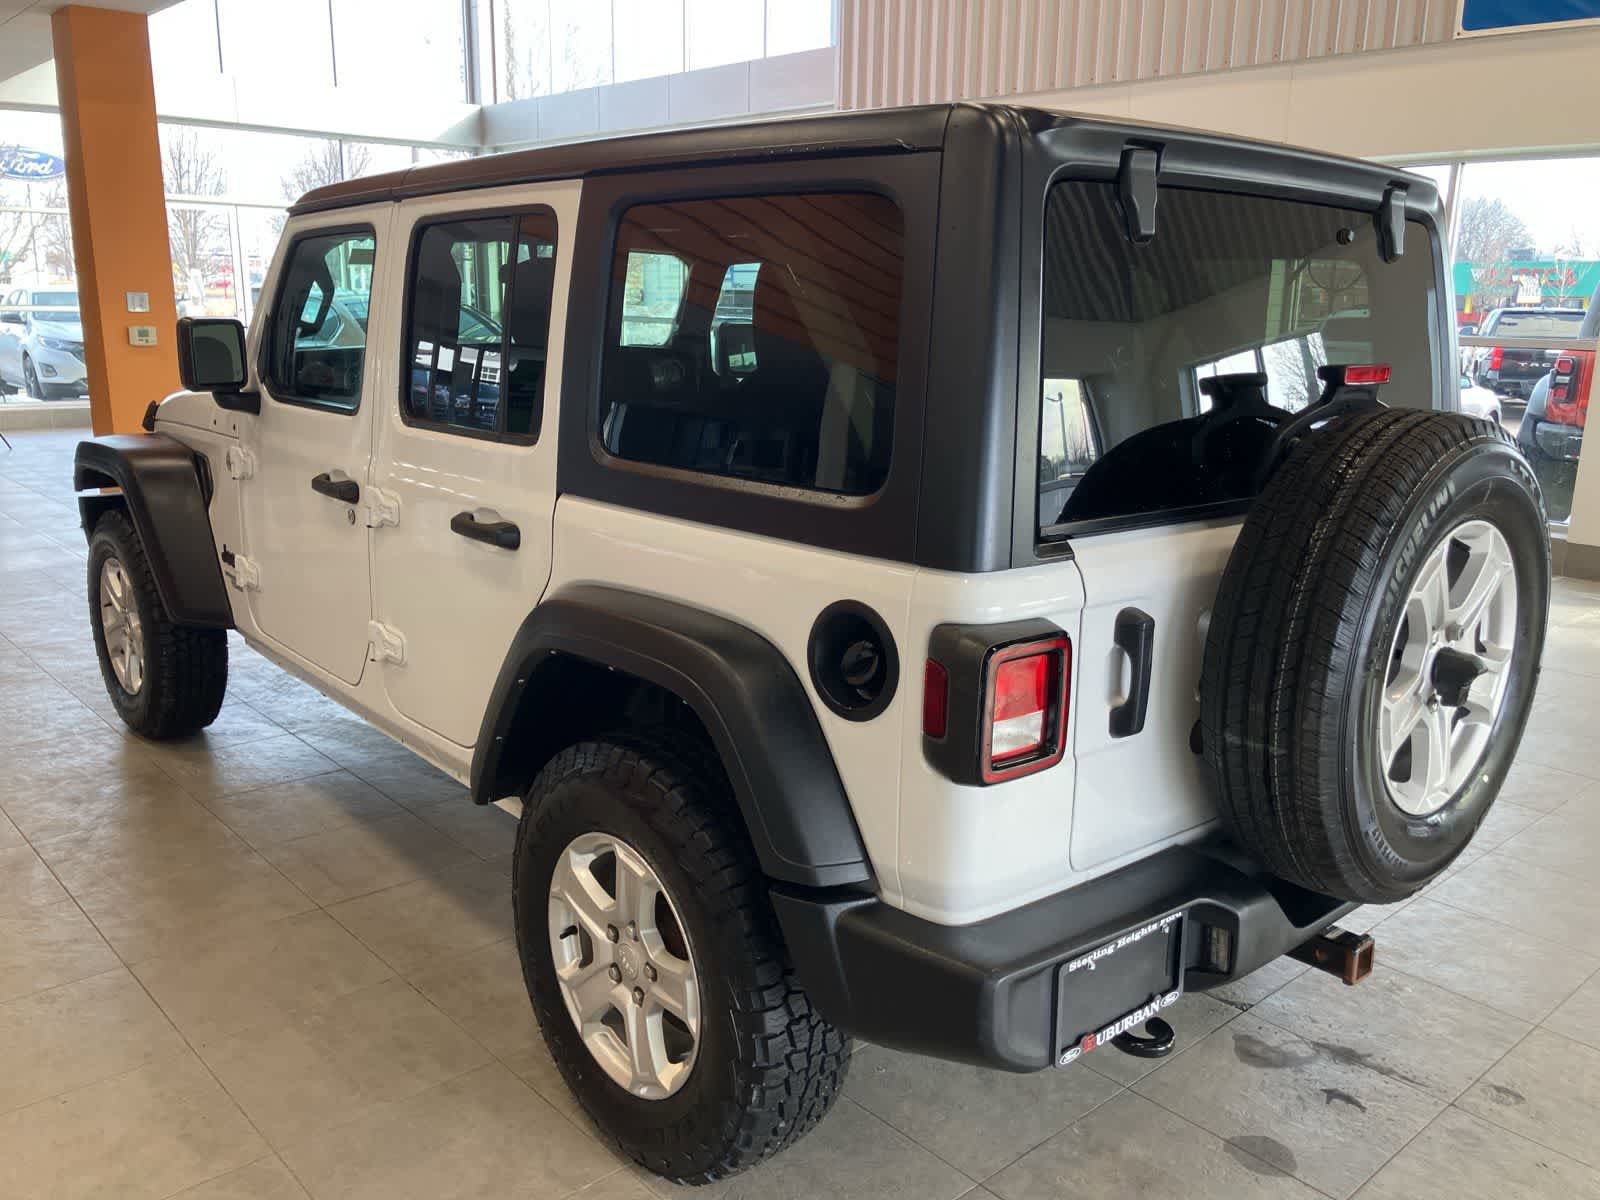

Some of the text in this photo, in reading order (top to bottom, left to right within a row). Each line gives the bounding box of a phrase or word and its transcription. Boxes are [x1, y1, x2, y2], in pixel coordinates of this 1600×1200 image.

[1068, 943, 1115, 972] Sterling
[1117, 922, 1158, 949] Heights
[1082, 1000, 1161, 1053] SUBURBAN
